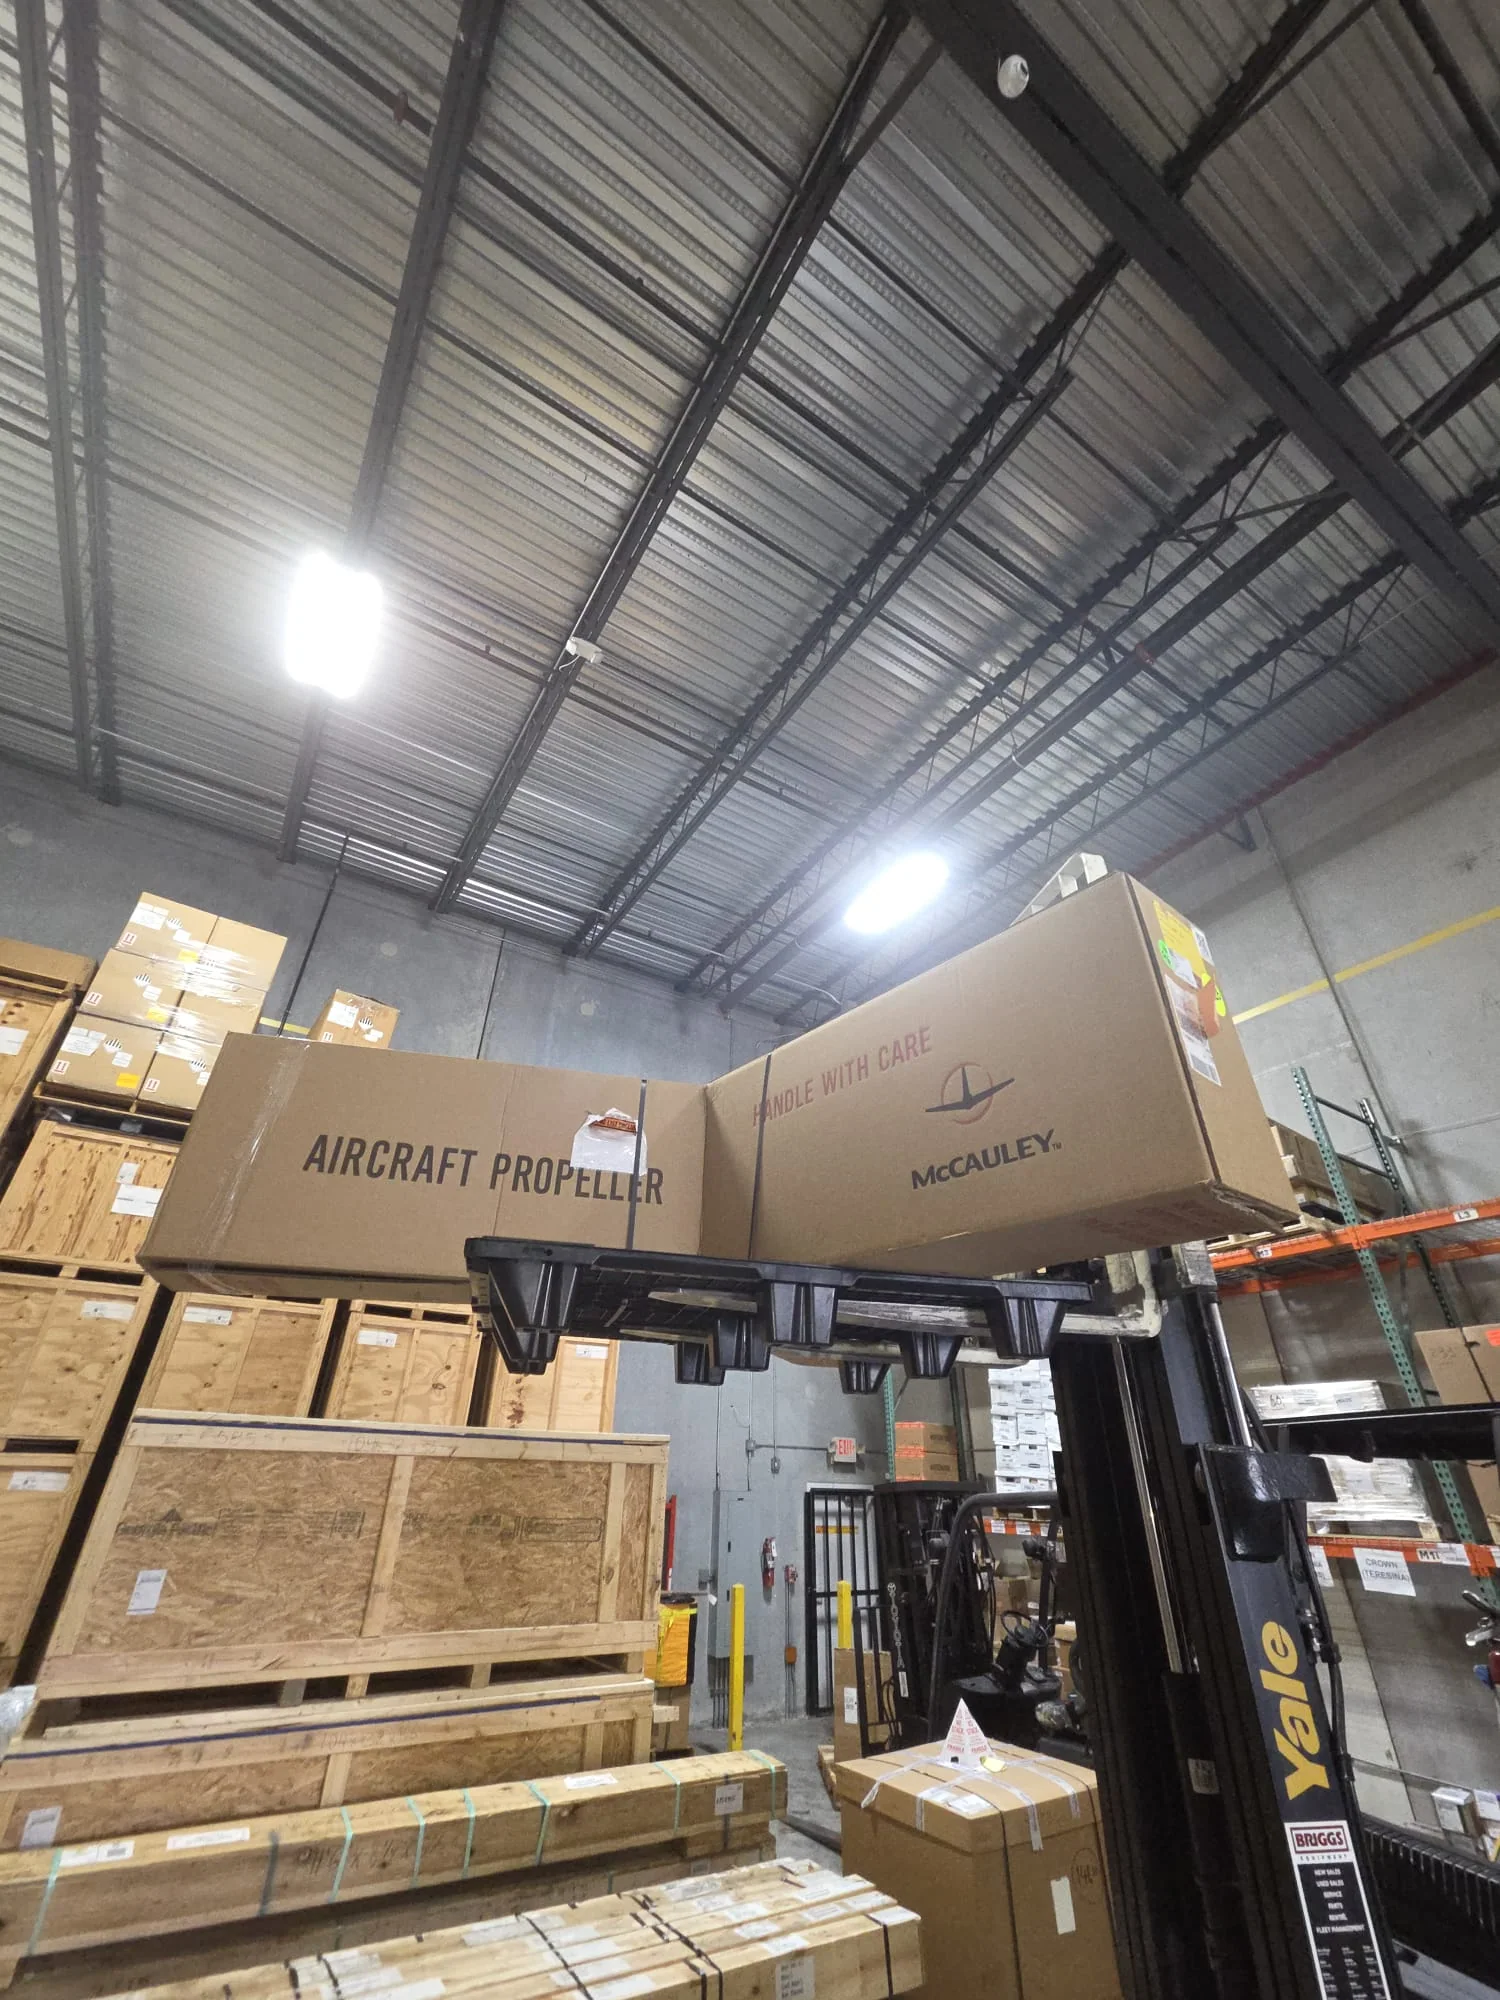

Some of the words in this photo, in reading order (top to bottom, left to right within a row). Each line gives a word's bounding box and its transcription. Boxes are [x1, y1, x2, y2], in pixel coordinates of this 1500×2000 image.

[753, 1080, 814, 1127] HANDLE
[822, 1054, 868, 1096] WITH
[878, 1026, 932, 1072] CARE
[303, 1134, 478, 1188] AIRCRAFT
[489, 1153, 664, 1205] PROPELLER
[1365, 1558, 1398, 1568] CROWN
[1259, 1620, 1330, 1801] Yale
[1294, 1832, 1345, 1848] BRIGGS
